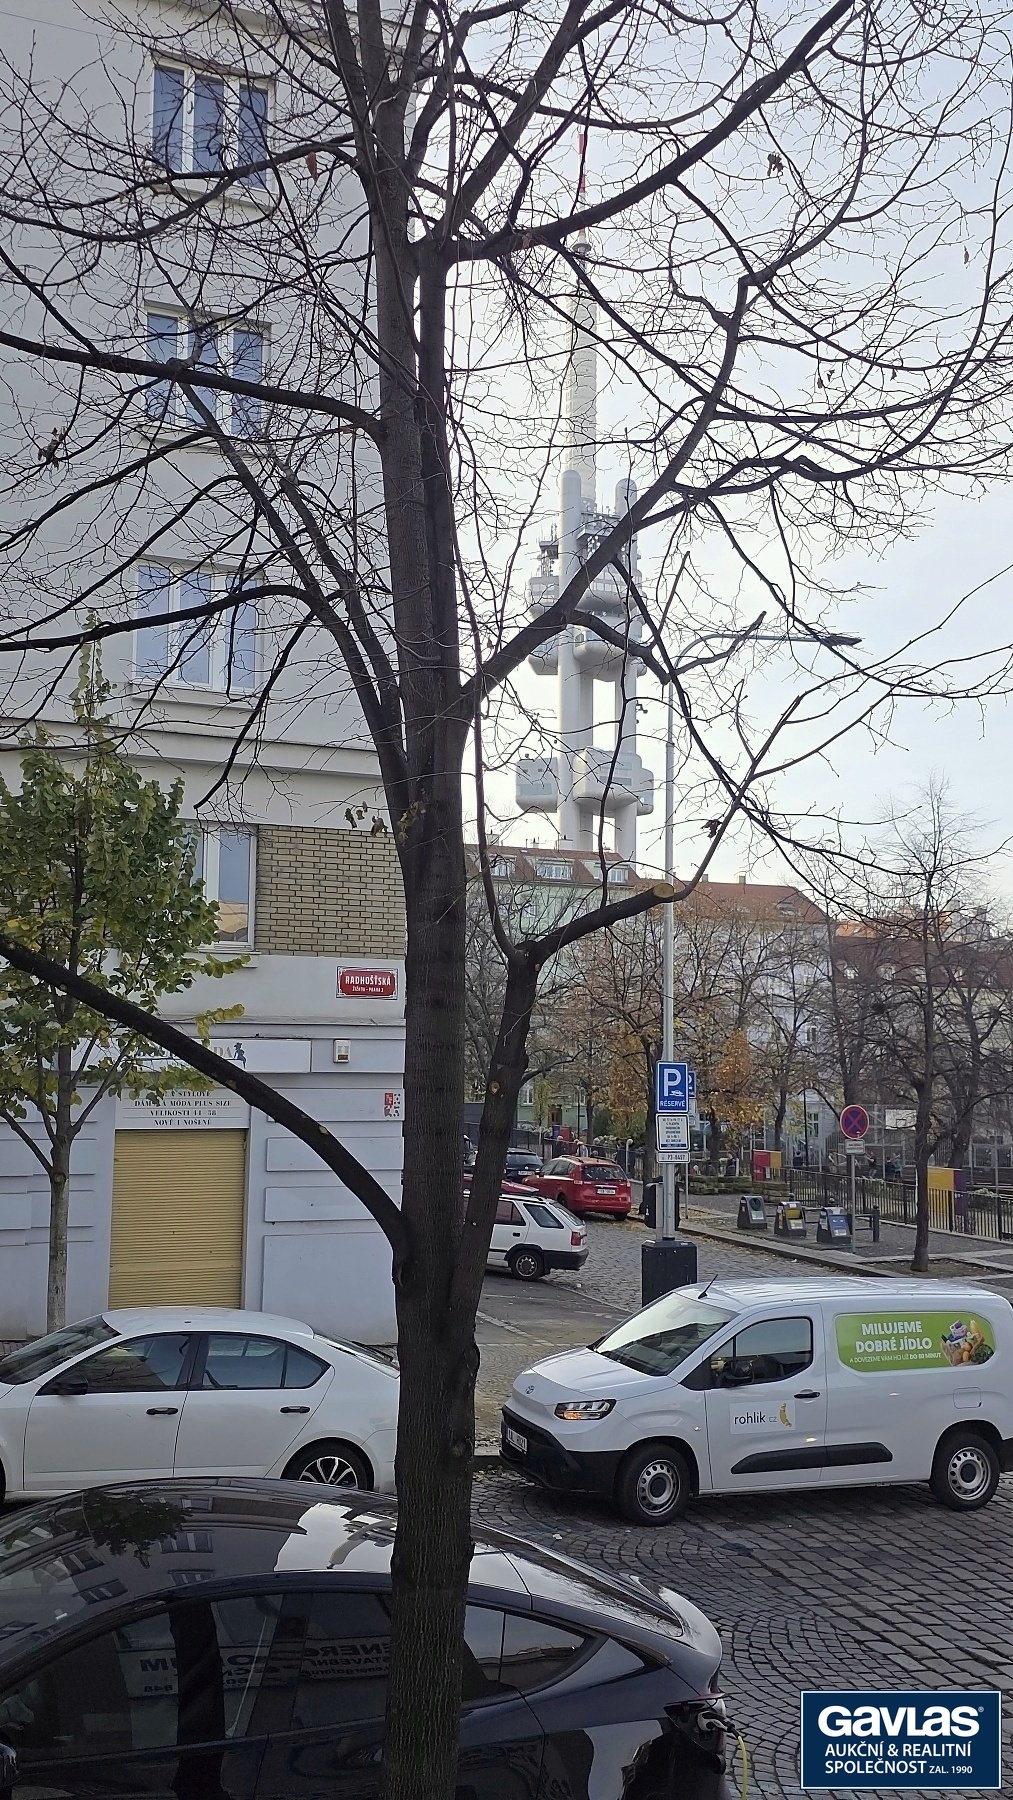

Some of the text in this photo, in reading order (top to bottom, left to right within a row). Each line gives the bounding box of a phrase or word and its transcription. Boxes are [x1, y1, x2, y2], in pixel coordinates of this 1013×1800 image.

[345, 974, 391, 986] RADHOŠŤSKÁ
[664, 1068, 681, 1097] P
[861, 1321, 923, 1336] MILUJEME
[856, 1336, 933, 1353] DOBRÉ JÍDLO
